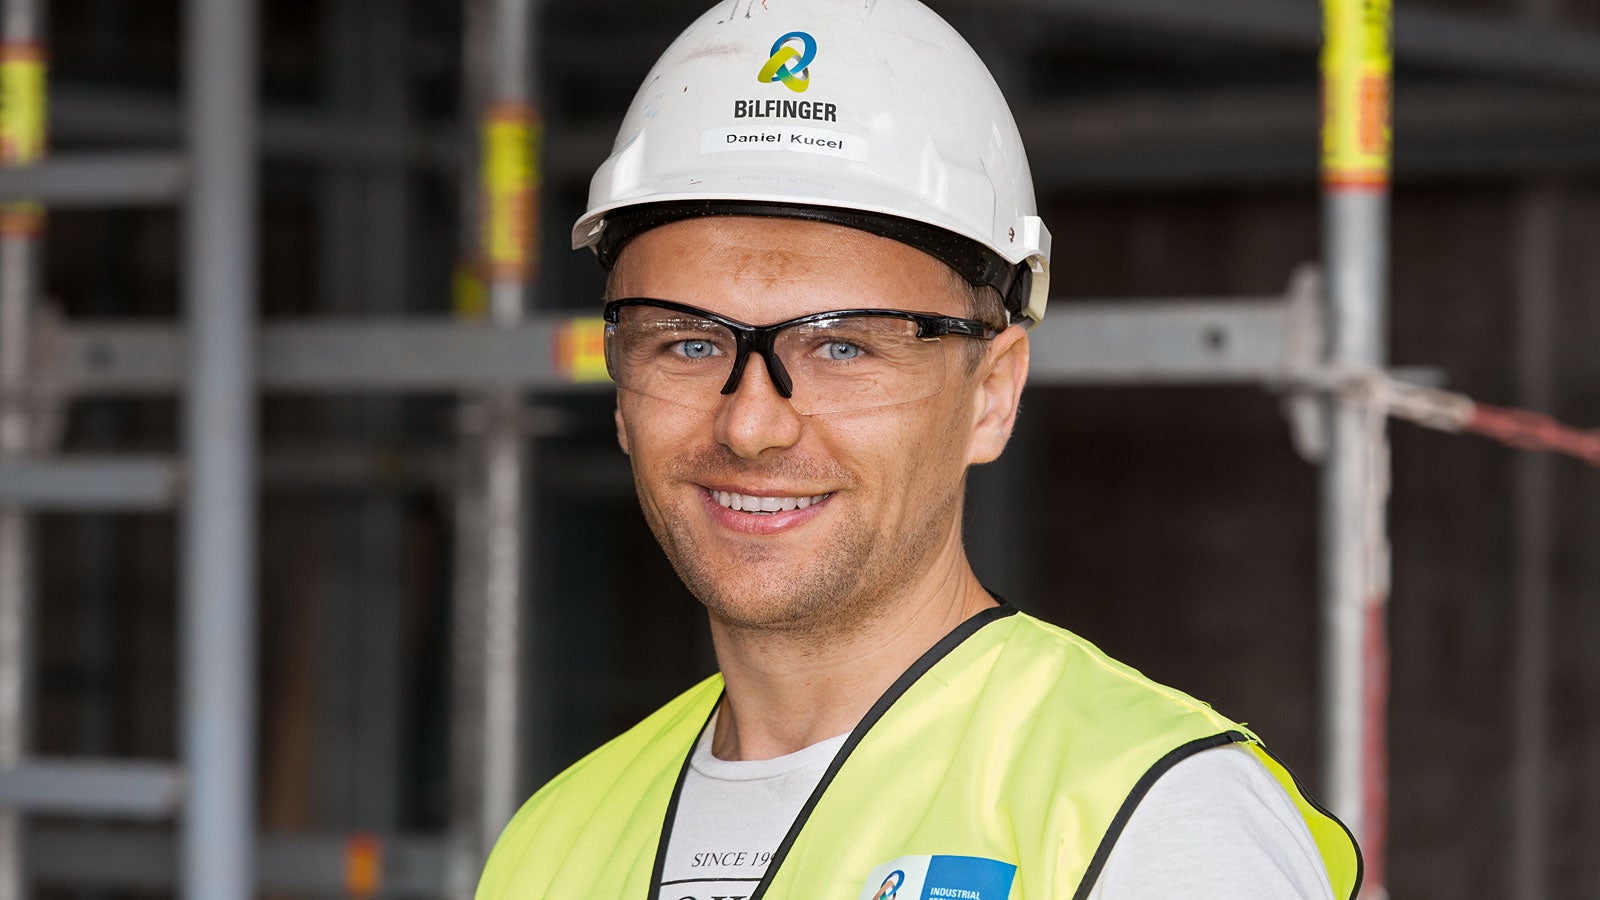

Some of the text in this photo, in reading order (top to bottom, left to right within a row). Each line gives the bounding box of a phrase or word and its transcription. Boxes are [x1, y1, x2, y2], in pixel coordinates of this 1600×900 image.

[726, 133, 843, 150] Daniel Kucel
[691, 851, 748, 868] SINCE
[930, 887, 981, 900] INDUSTRIAL
